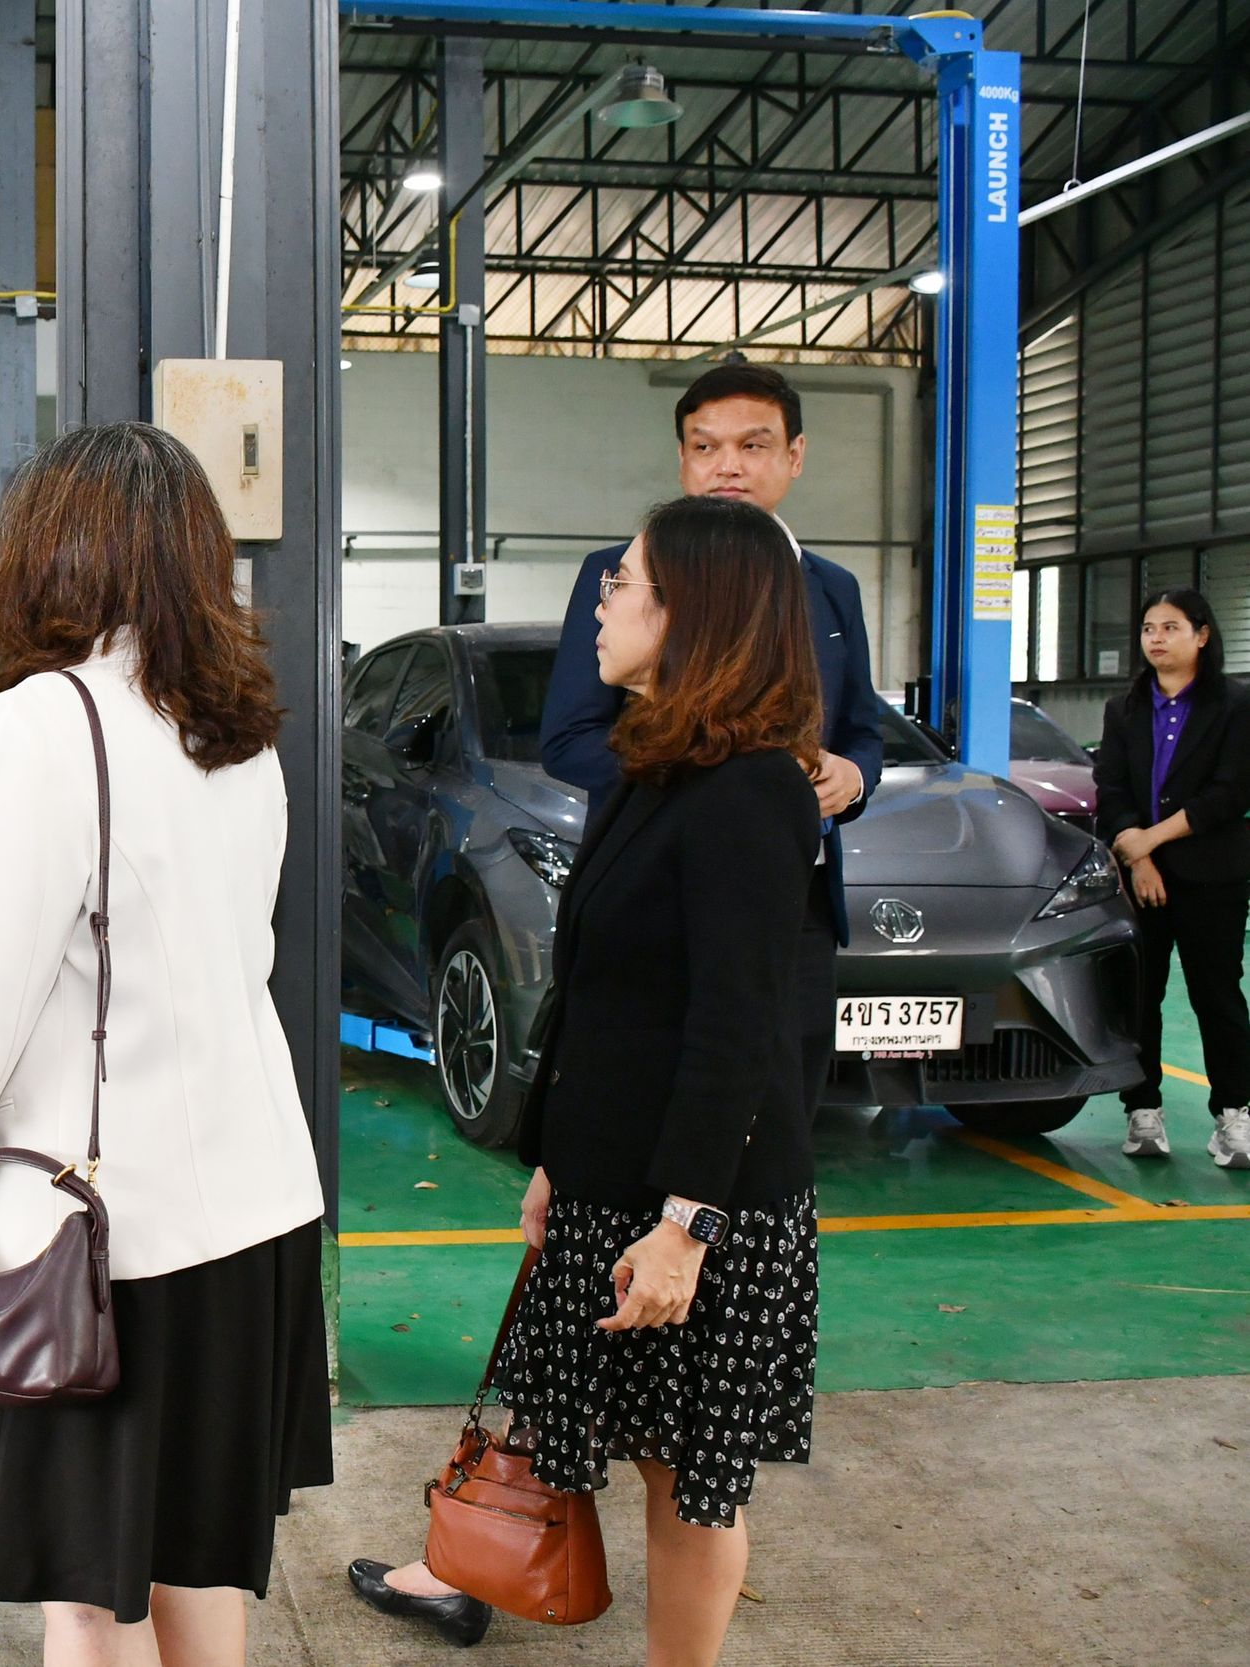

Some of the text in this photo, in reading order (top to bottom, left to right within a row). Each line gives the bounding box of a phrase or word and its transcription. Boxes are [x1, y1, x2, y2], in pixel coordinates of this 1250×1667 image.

[979, 85, 1019, 103] 4000Kg
[987, 112, 1009, 223] LAUNCH
[899, 1001, 958, 1026] 3757
